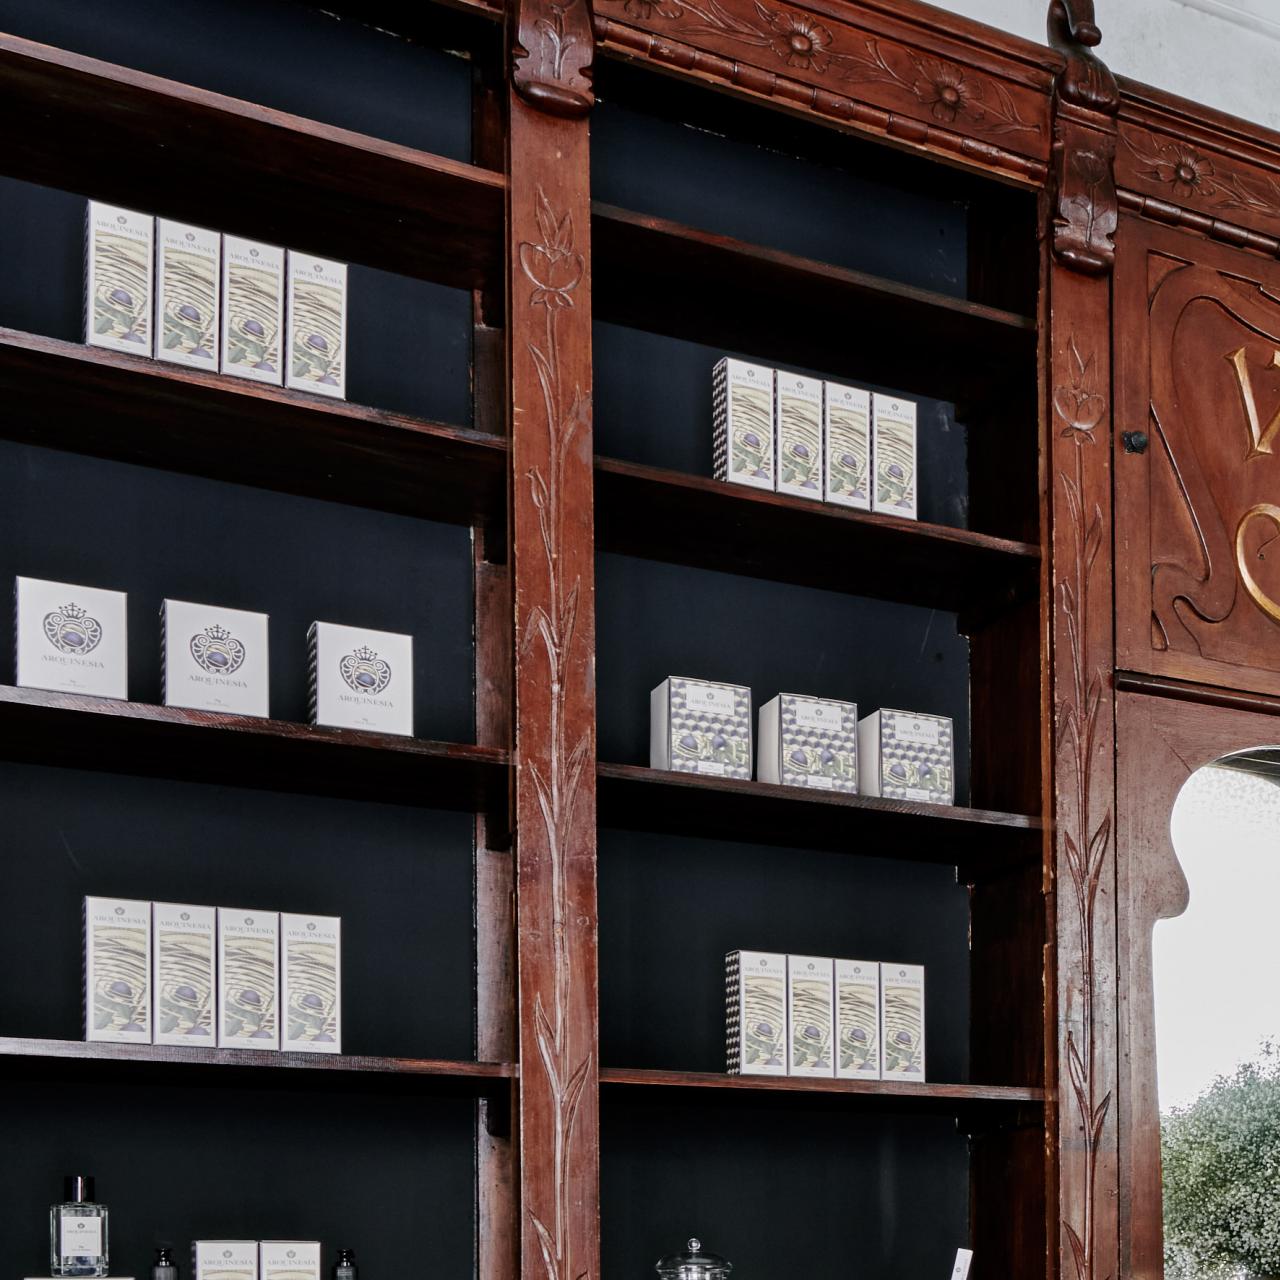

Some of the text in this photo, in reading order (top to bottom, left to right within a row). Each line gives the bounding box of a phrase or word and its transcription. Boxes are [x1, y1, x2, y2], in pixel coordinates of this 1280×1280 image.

[41, 654, 105, 669] ARQUINESIA
[189, 674, 248, 689] ARQUINESIA
[339, 694, 394, 709] ARQUINESIA
